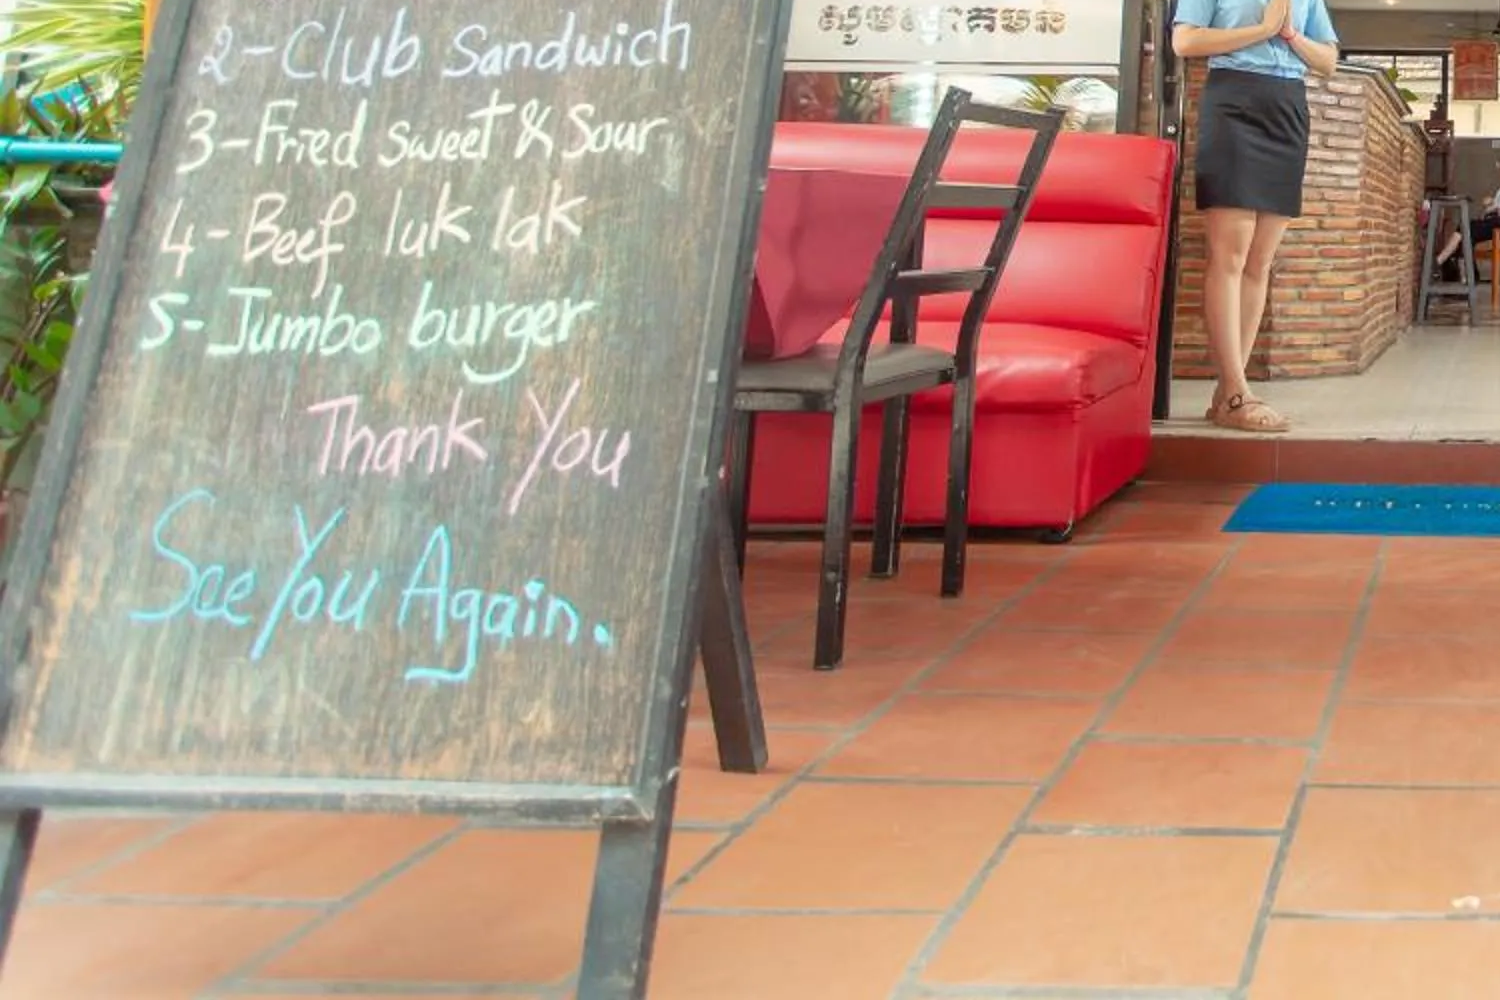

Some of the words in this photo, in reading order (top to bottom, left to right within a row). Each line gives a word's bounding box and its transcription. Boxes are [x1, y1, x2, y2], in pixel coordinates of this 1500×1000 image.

[513, 97, 554, 160] &
[562, 103, 670, 159] Sour
[385, 181, 472, 255] luk
[493, 180, 587, 254] lak
[409, 281, 595, 385] burger
[308, 387, 489, 476] Thank
[507, 377, 632, 515] You
[130, 488, 256, 626] See
[250, 503, 381, 663] You
[397, 524, 614, 683] Again.
